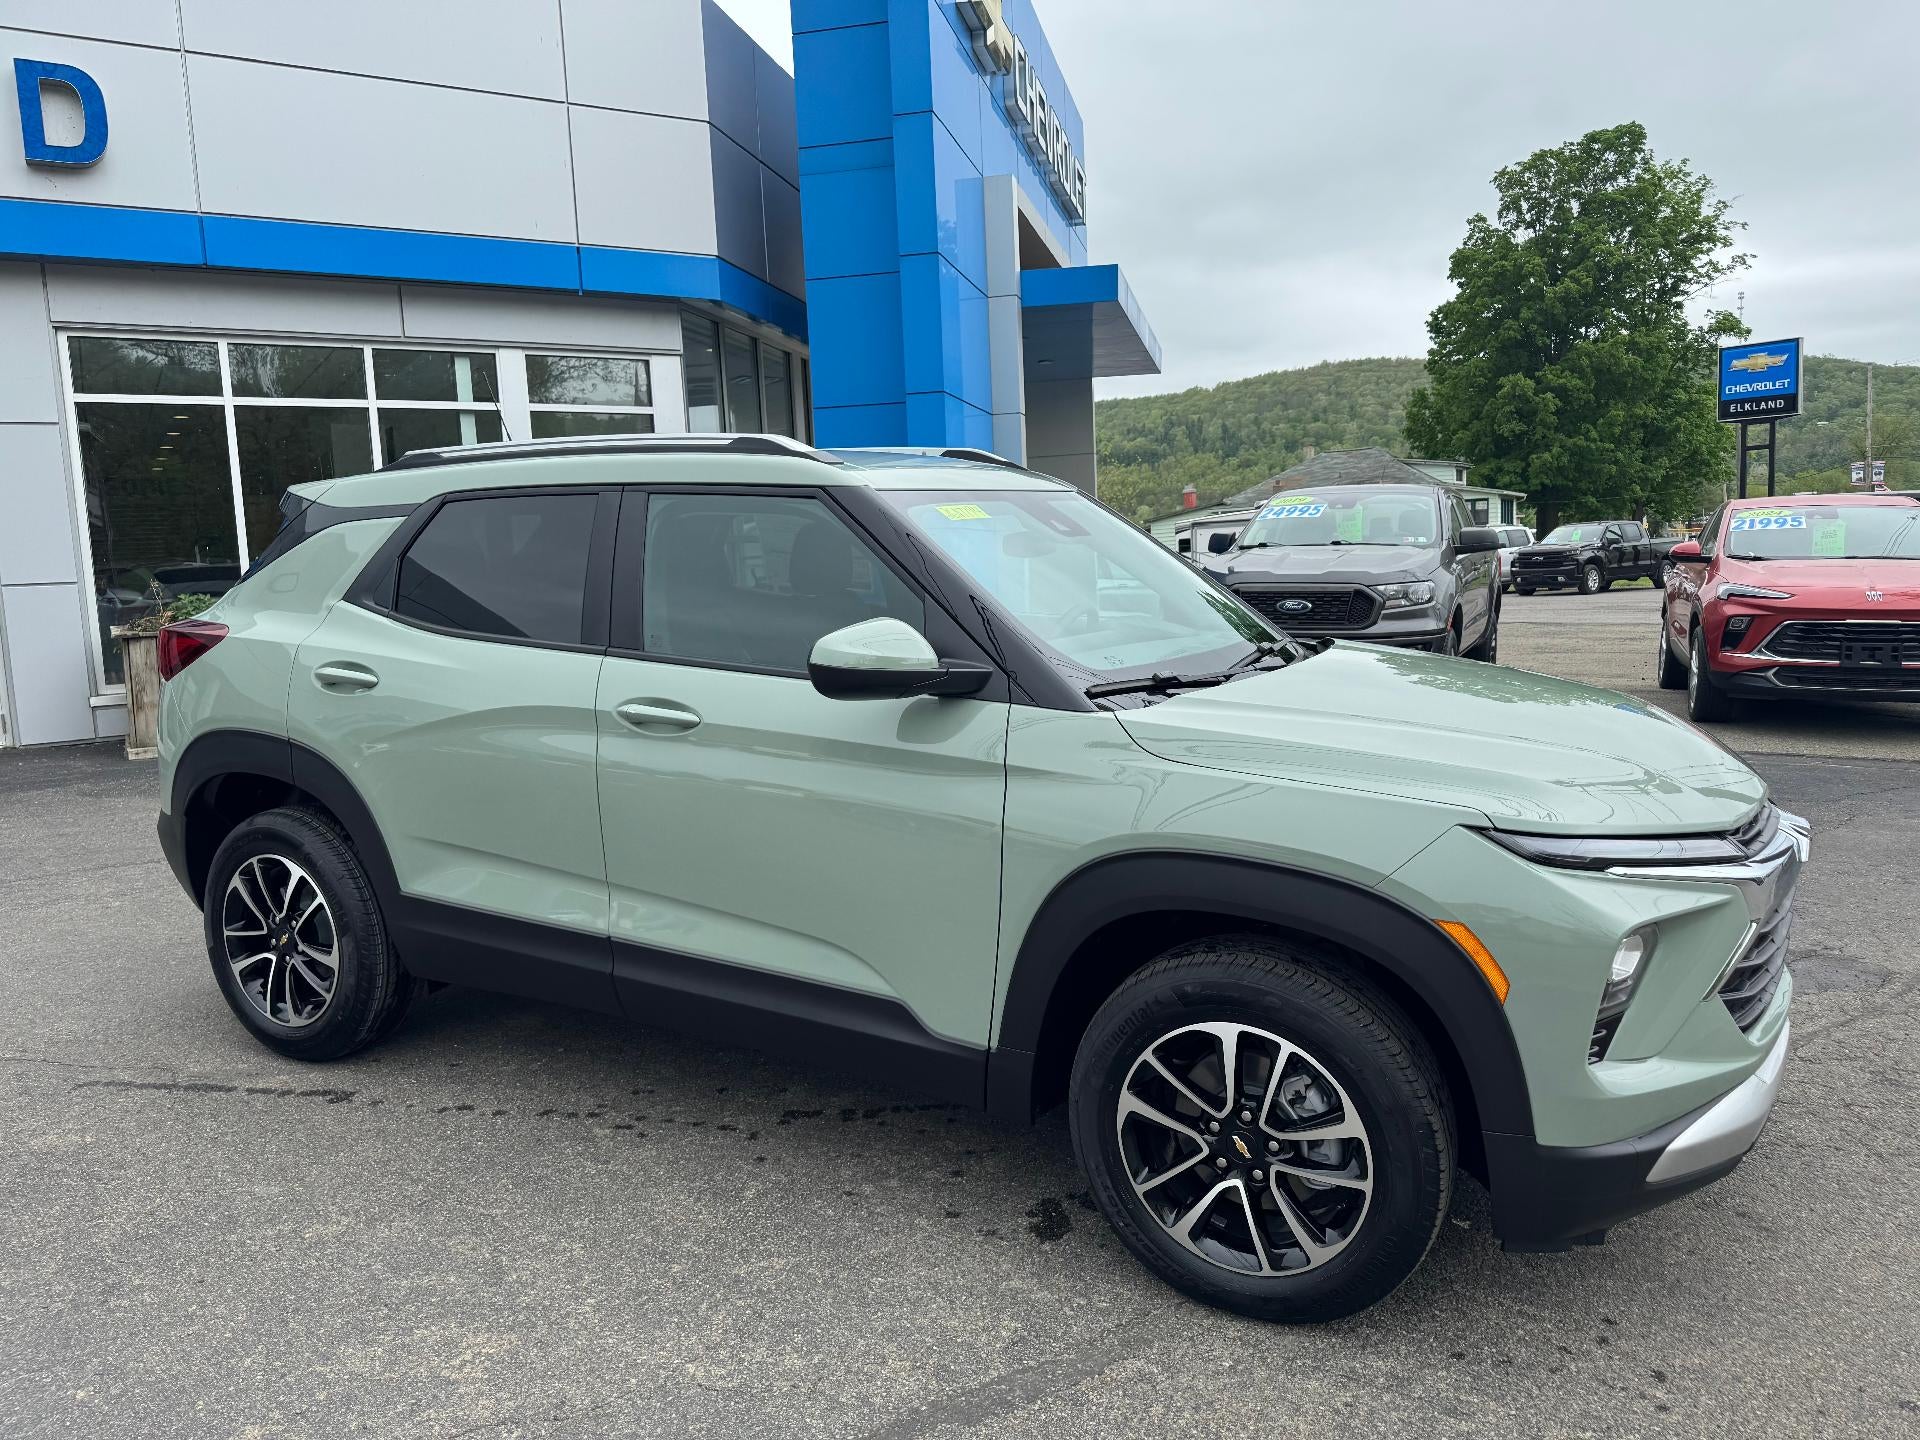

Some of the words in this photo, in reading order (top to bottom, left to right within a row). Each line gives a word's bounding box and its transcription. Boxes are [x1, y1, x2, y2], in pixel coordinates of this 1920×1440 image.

[13, 57, 109, 166] D
[1011, 34, 1087, 225] CHEVROLET
[1725, 378, 1791, 395] CHEVROLET
[1729, 399, 1785, 413] ELKLAND
[1258, 505, 1324, 519] 24995
[1730, 516, 1804, 531] 21995
